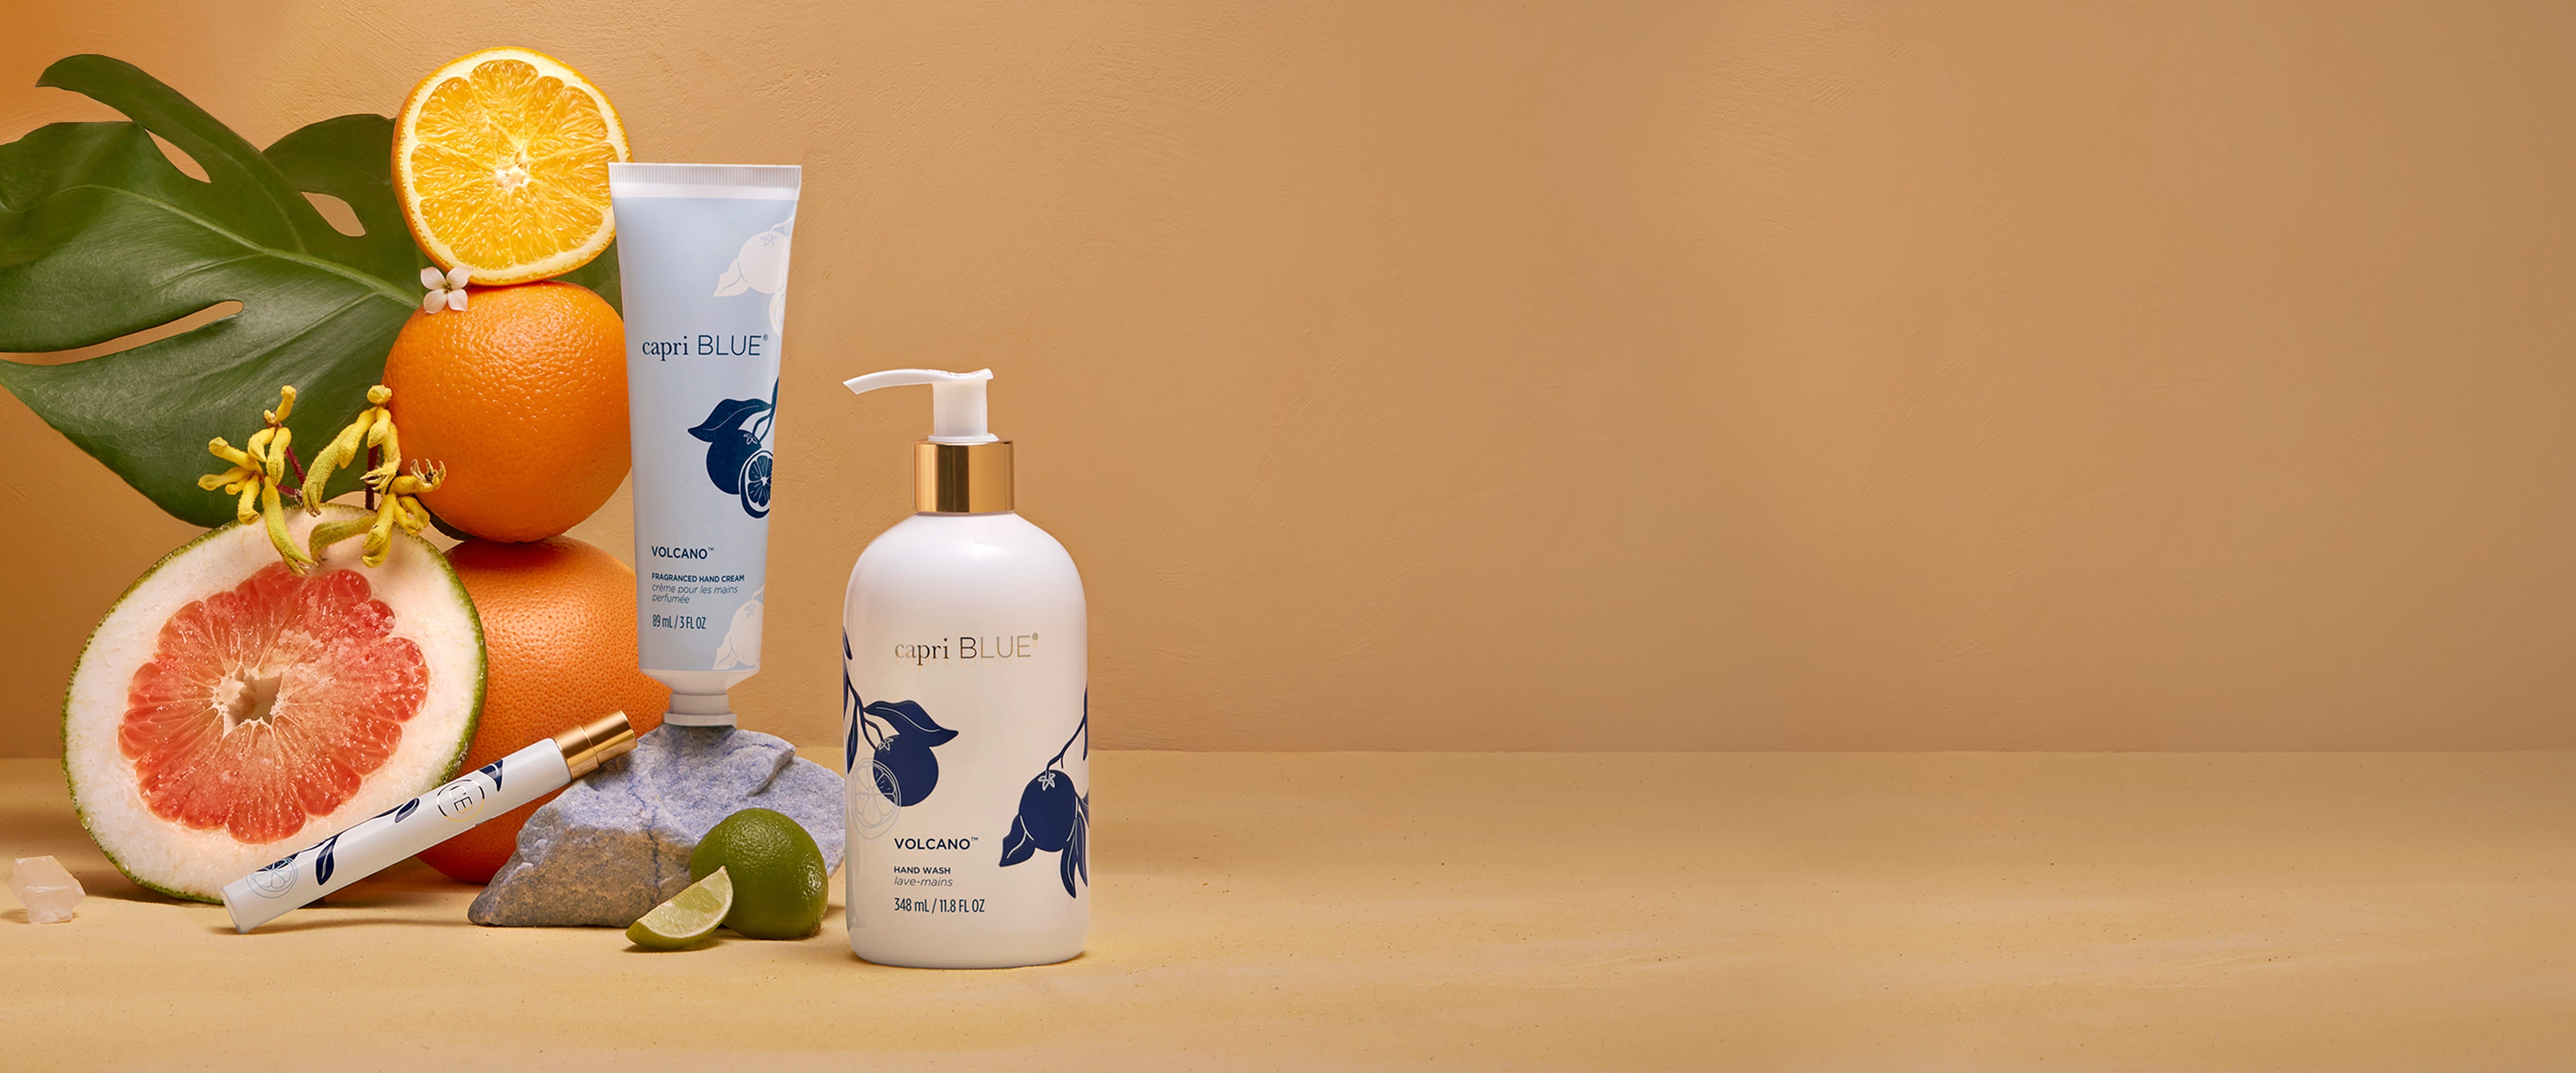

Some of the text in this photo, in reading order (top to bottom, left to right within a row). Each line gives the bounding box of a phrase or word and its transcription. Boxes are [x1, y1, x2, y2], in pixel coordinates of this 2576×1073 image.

[642, 335, 689, 361] capri
[652, 572, 697, 582] FRAGRANCED
[721, 574, 745, 583] CREAM
[652, 584, 738, 596] crème pour les mains
[652, 593, 690, 604] perfumée
[652, 614, 661, 627] 89
[662, 616, 673, 628] mL
[680, 616, 684, 629] 3
[686, 616, 694, 629] FL
[696, 616, 706, 629] OZ
[895, 638, 949, 666] capri
[894, 876, 953, 886] lave-mains
[894, 898, 912, 912] 348
[915, 899, 929, 912] mL
[939, 899, 956, 913] 11.8
[959, 899, 969, 913] FL
[972, 899, 985, 913] OZ
